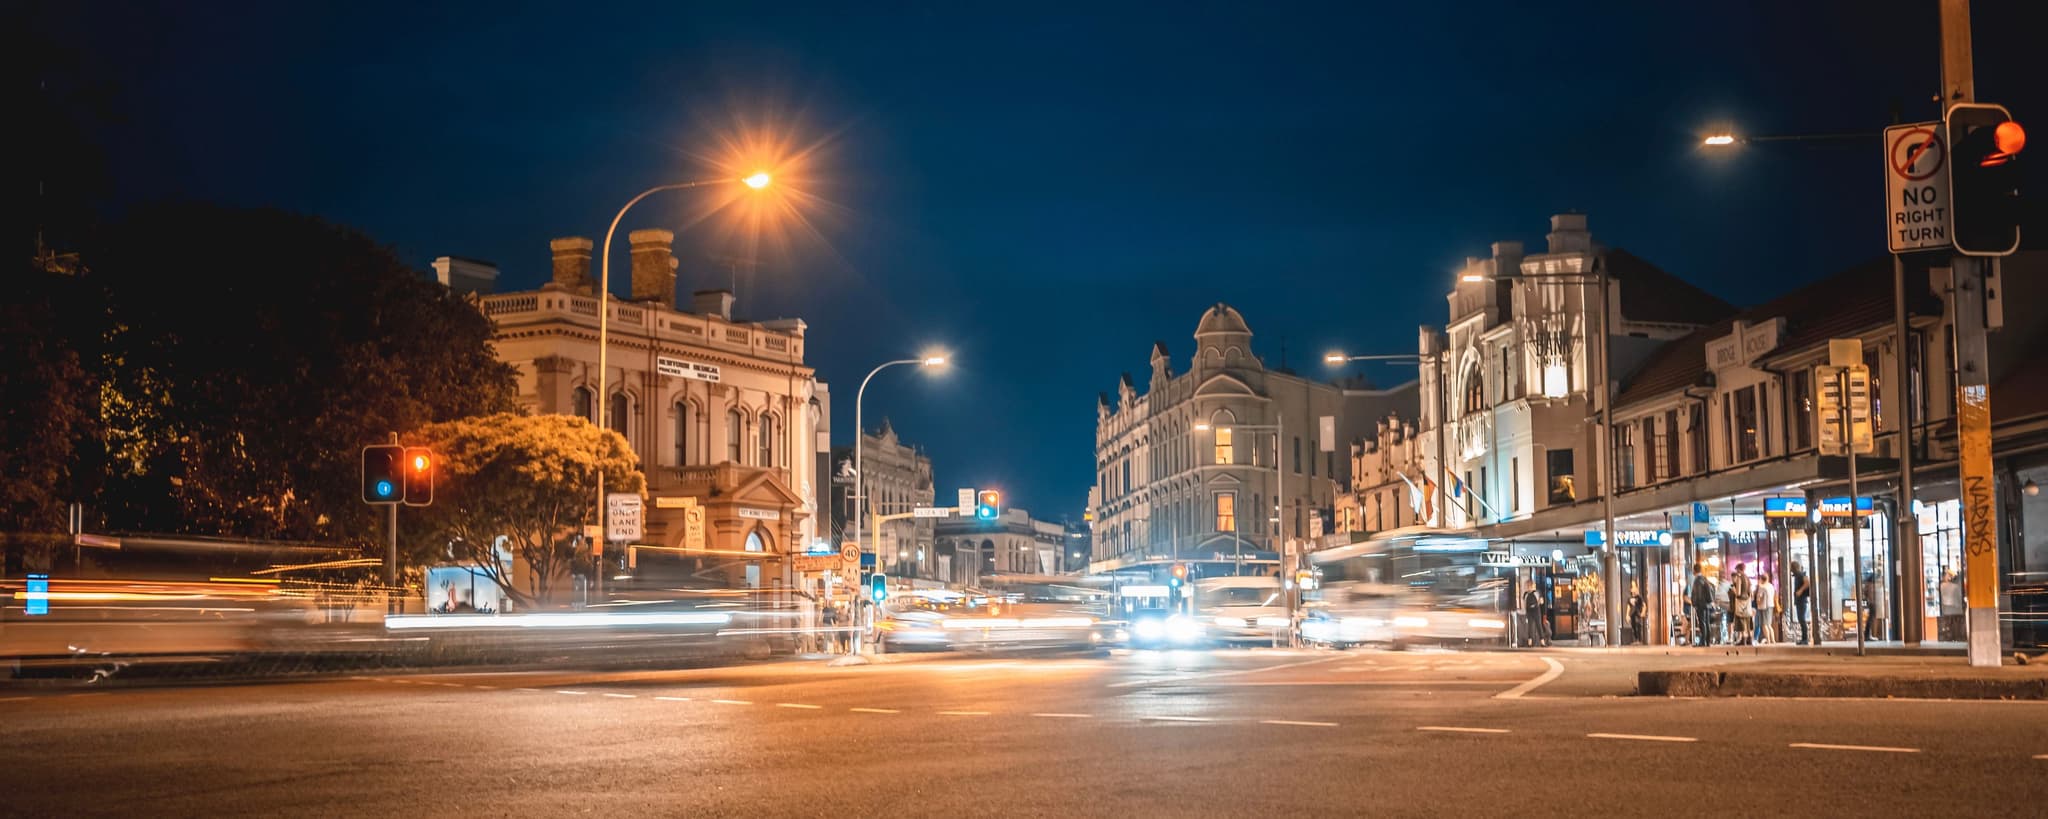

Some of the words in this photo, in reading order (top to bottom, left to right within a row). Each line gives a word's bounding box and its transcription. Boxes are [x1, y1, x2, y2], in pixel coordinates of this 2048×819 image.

[1903, 186, 1937, 207] NO
[1895, 208, 1945, 225] RIGHT
[1898, 227, 1945, 243] TURN
[612, 519, 636, 527] LANE
[845, 549, 857, 558] 40
